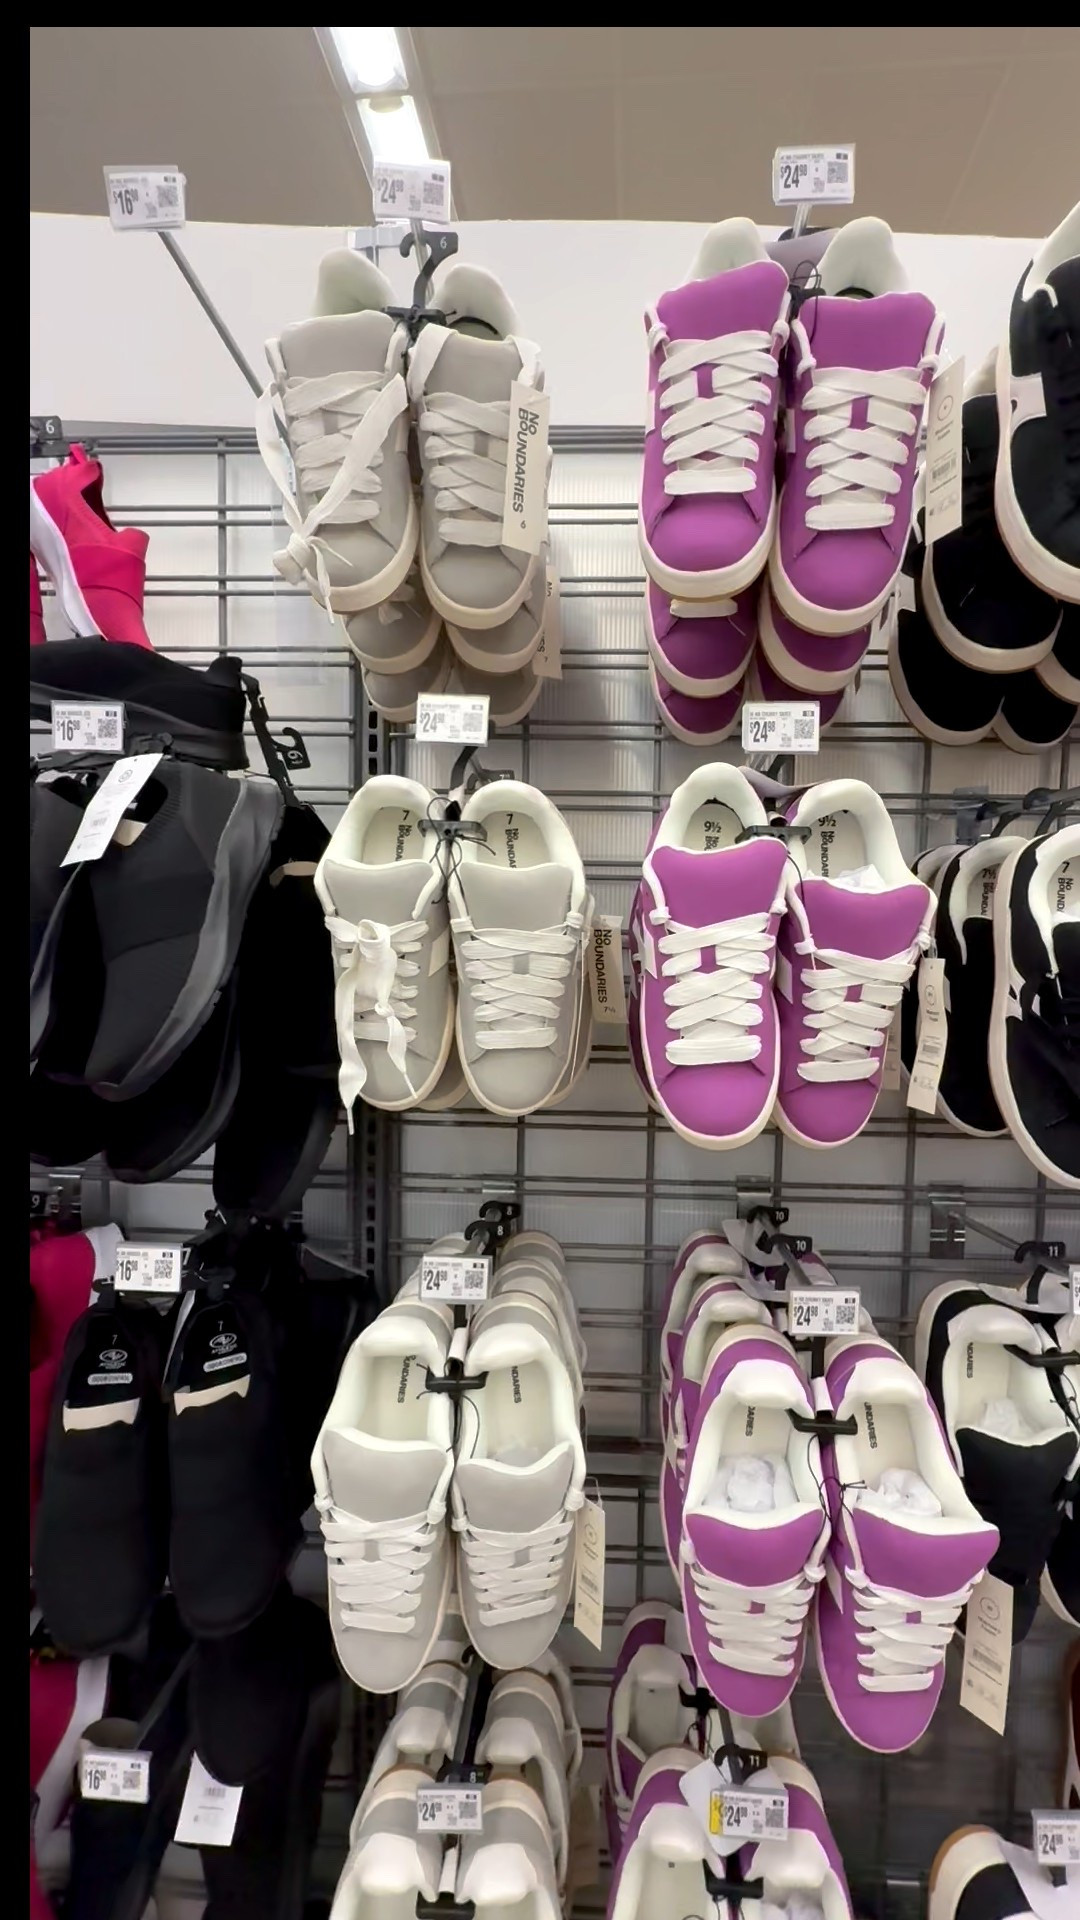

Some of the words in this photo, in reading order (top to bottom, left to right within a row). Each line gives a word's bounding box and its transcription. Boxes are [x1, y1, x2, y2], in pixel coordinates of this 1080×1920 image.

[440, 237, 447, 249] 6
[45, 419, 55, 434] 6
[528, 411, 540, 436] NO
[513, 407, 528, 513] BOUNDARIES
[520, 519, 526, 529] 6
[402, 810, 410, 820] 7
[506, 813, 514, 825] 7
[1062, 861, 1070, 873] 7
[1057, 877, 1065, 912] BOUND
[603, 929, 612, 946] NO
[594, 929, 608, 1004] BOUNDARIES
[31, 1195, 40, 1208] 9
[775, 1211, 785, 1220] 10
[497, 1225, 504, 1236] 8
[796, 1240, 806, 1251] 10
[1049, 1246, 1058, 1257] 11
[749, 1755, 760, 1767] 11
